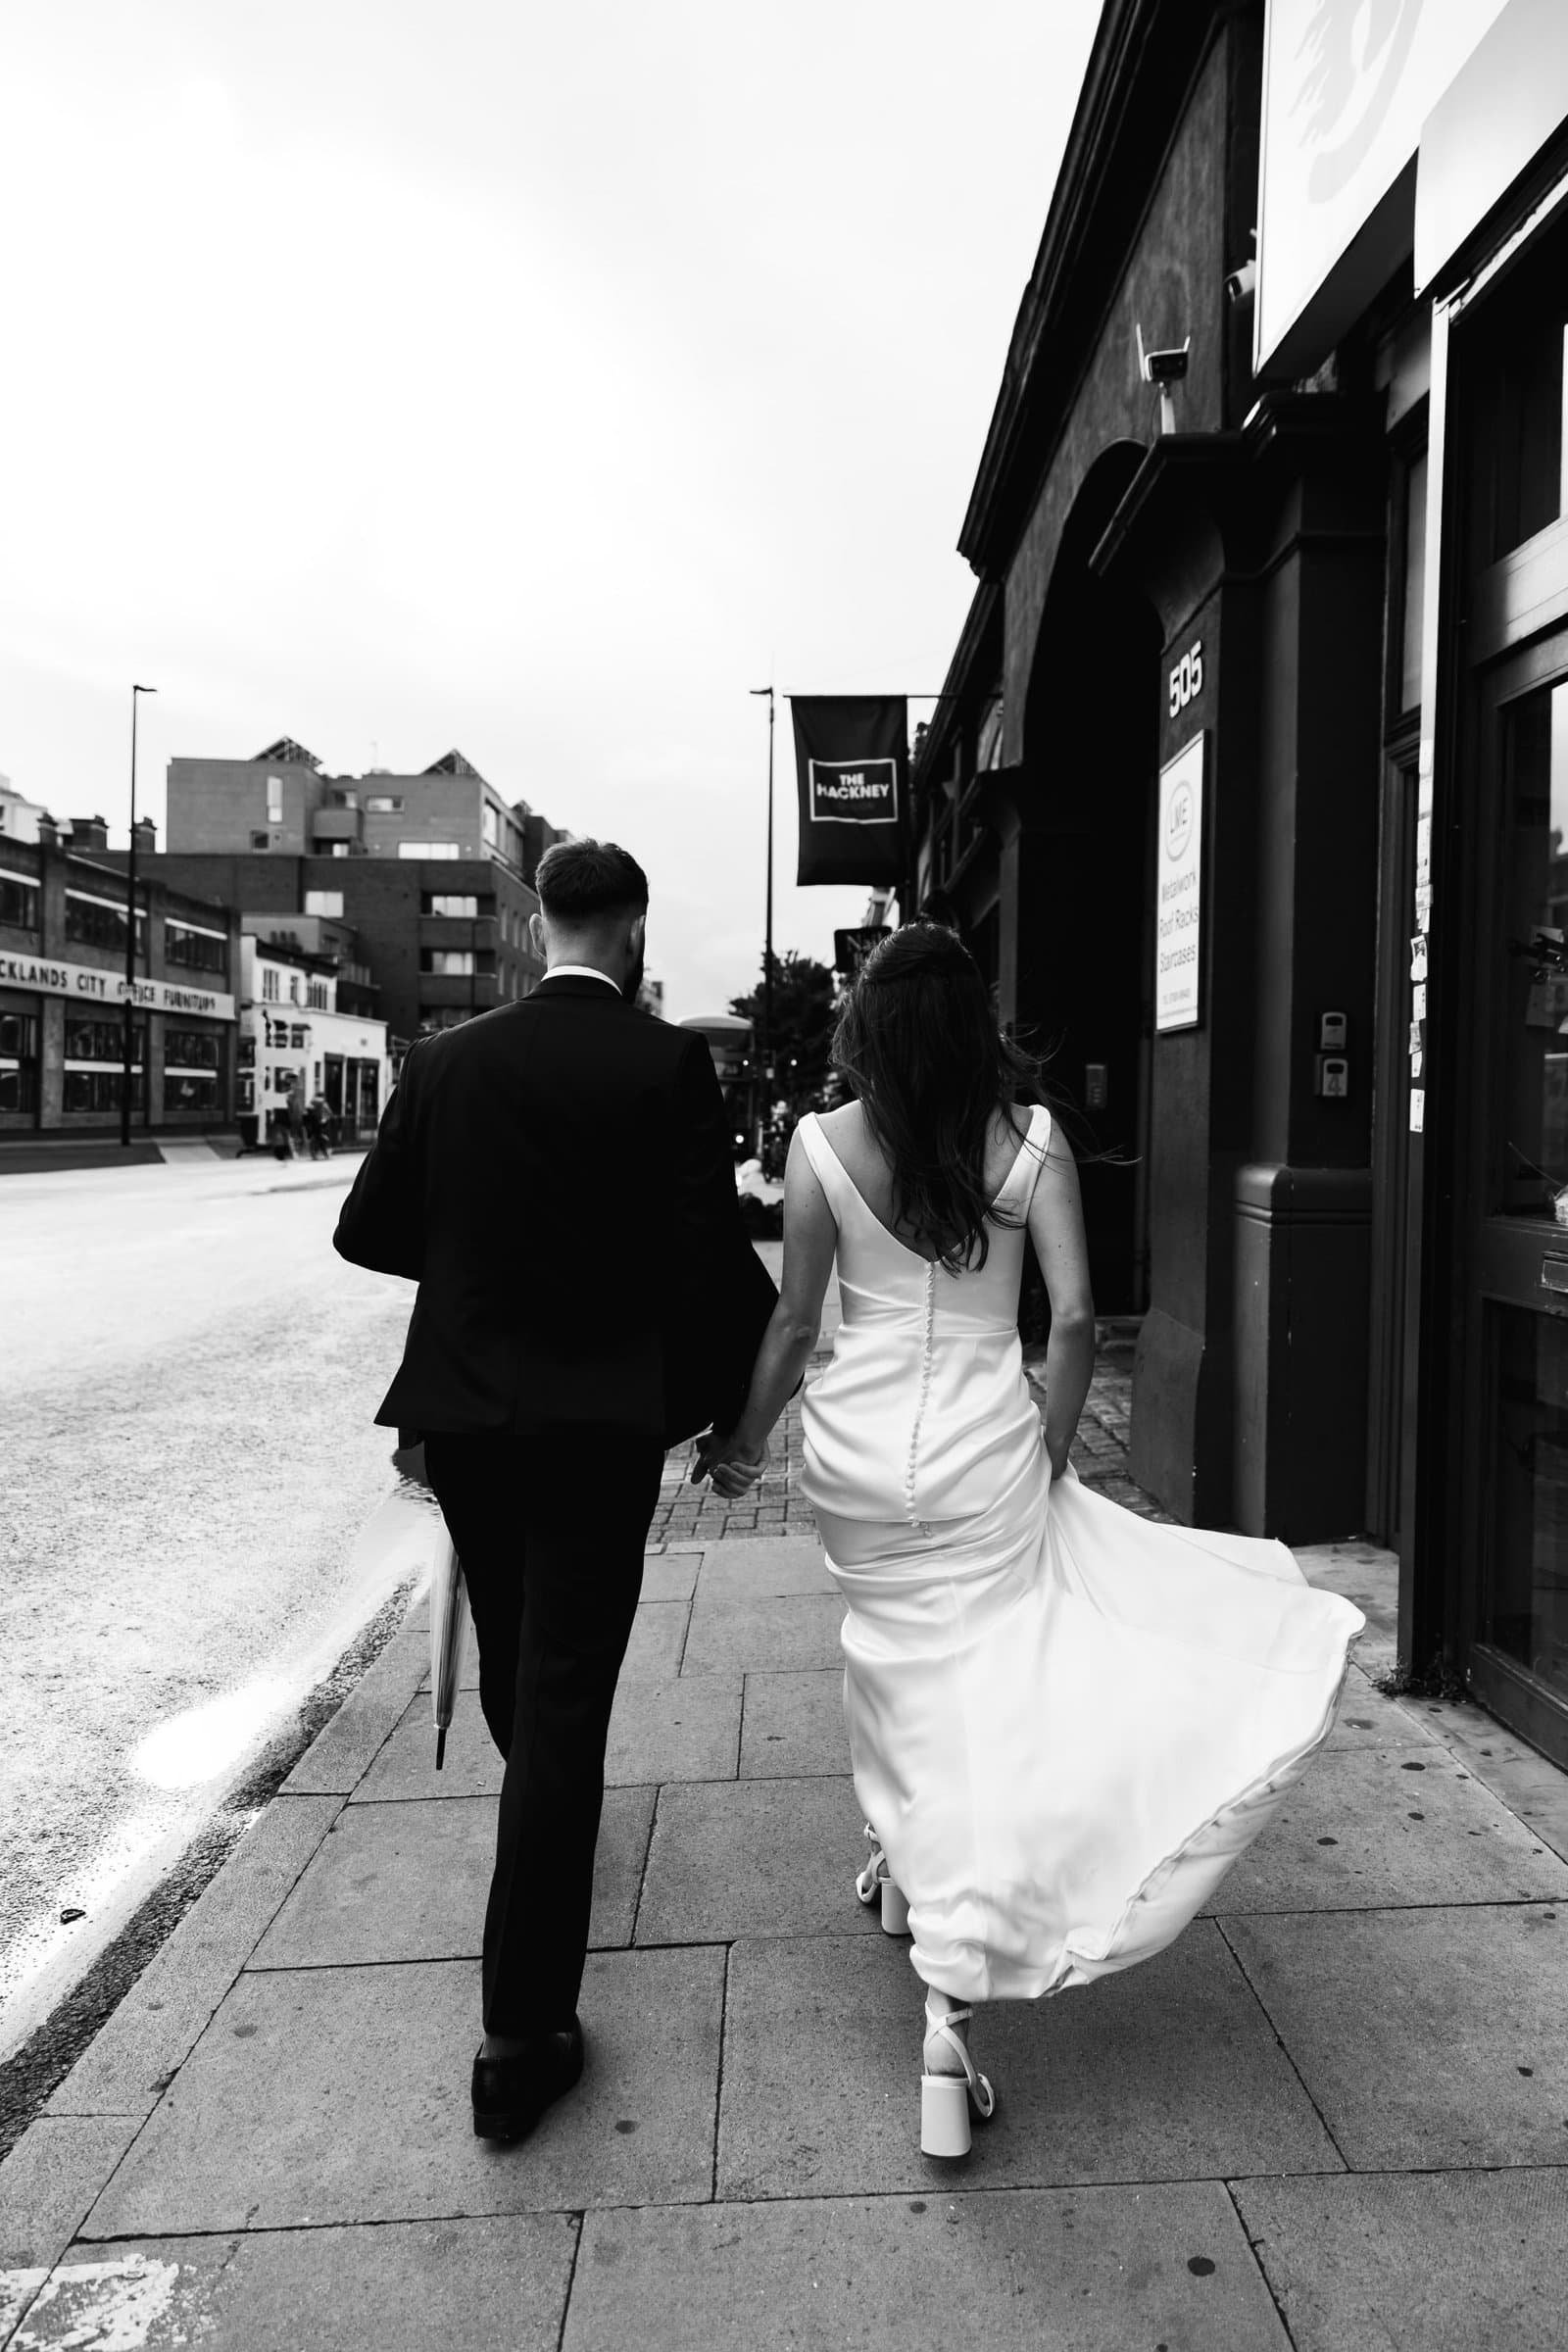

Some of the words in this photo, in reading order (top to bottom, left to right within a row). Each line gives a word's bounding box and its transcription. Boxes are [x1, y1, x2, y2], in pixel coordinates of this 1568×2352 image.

[1169, 640, 1202, 718] 505
[839, 772, 864, 786] THE
[816, 783, 890, 800] HACKNEY
[77, 973, 107, 997] CITY
[117, 981, 155, 1004] OFICE
